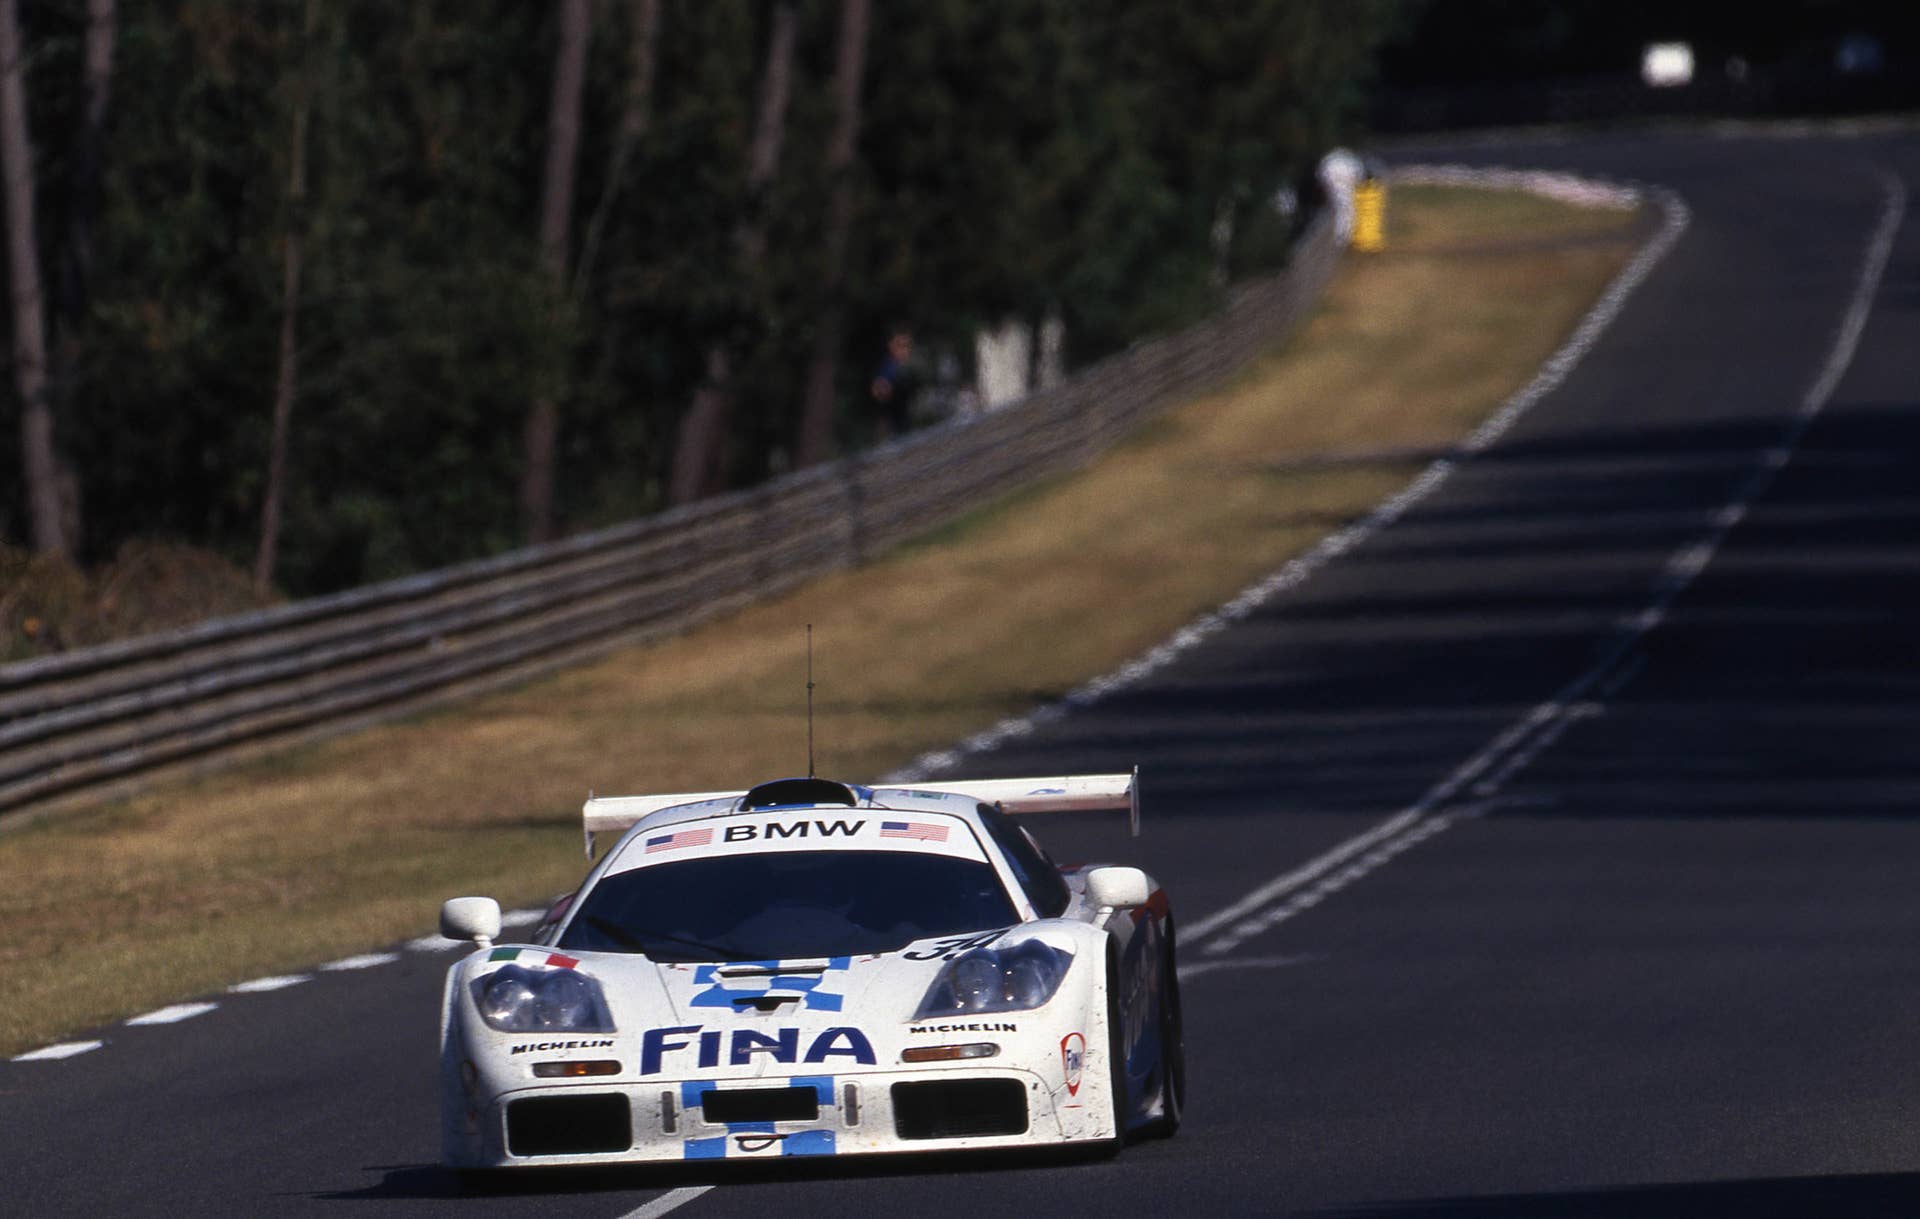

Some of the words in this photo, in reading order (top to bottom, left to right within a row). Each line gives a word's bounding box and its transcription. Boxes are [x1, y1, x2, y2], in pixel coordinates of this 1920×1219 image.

[724, 820, 866, 842] BMW
[911, 1023, 1017, 1034] MICHELIN
[511, 1040, 614, 1054] MICHELIN
[640, 1025, 877, 1076] FINA
